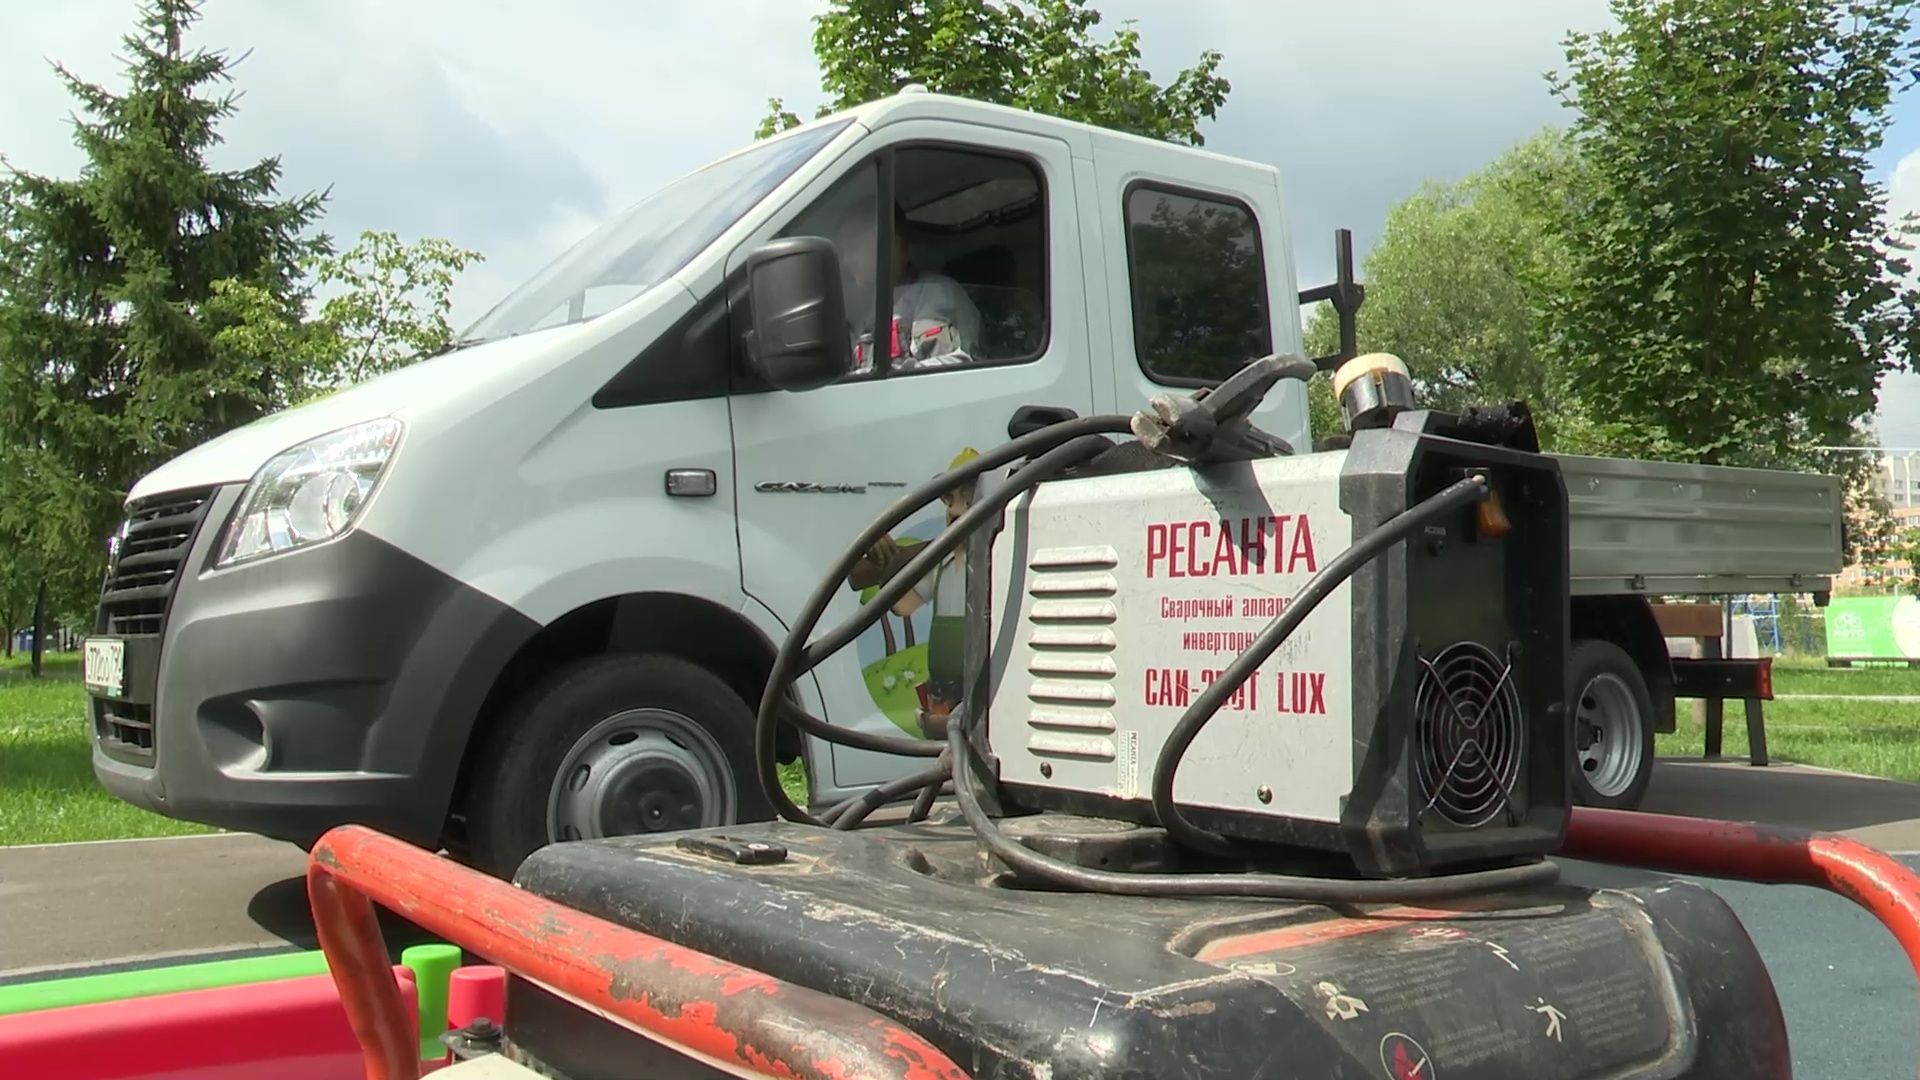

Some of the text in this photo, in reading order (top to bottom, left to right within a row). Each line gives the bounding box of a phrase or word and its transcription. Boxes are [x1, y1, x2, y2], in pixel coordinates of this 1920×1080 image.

[1147, 514, 1317, 578] РЕСАНТА
[1161, 595, 1294, 622] Сварочный аппар
[1183, 632, 1257, 655] инверторн
[1278, 672, 1326, 714] LUX
